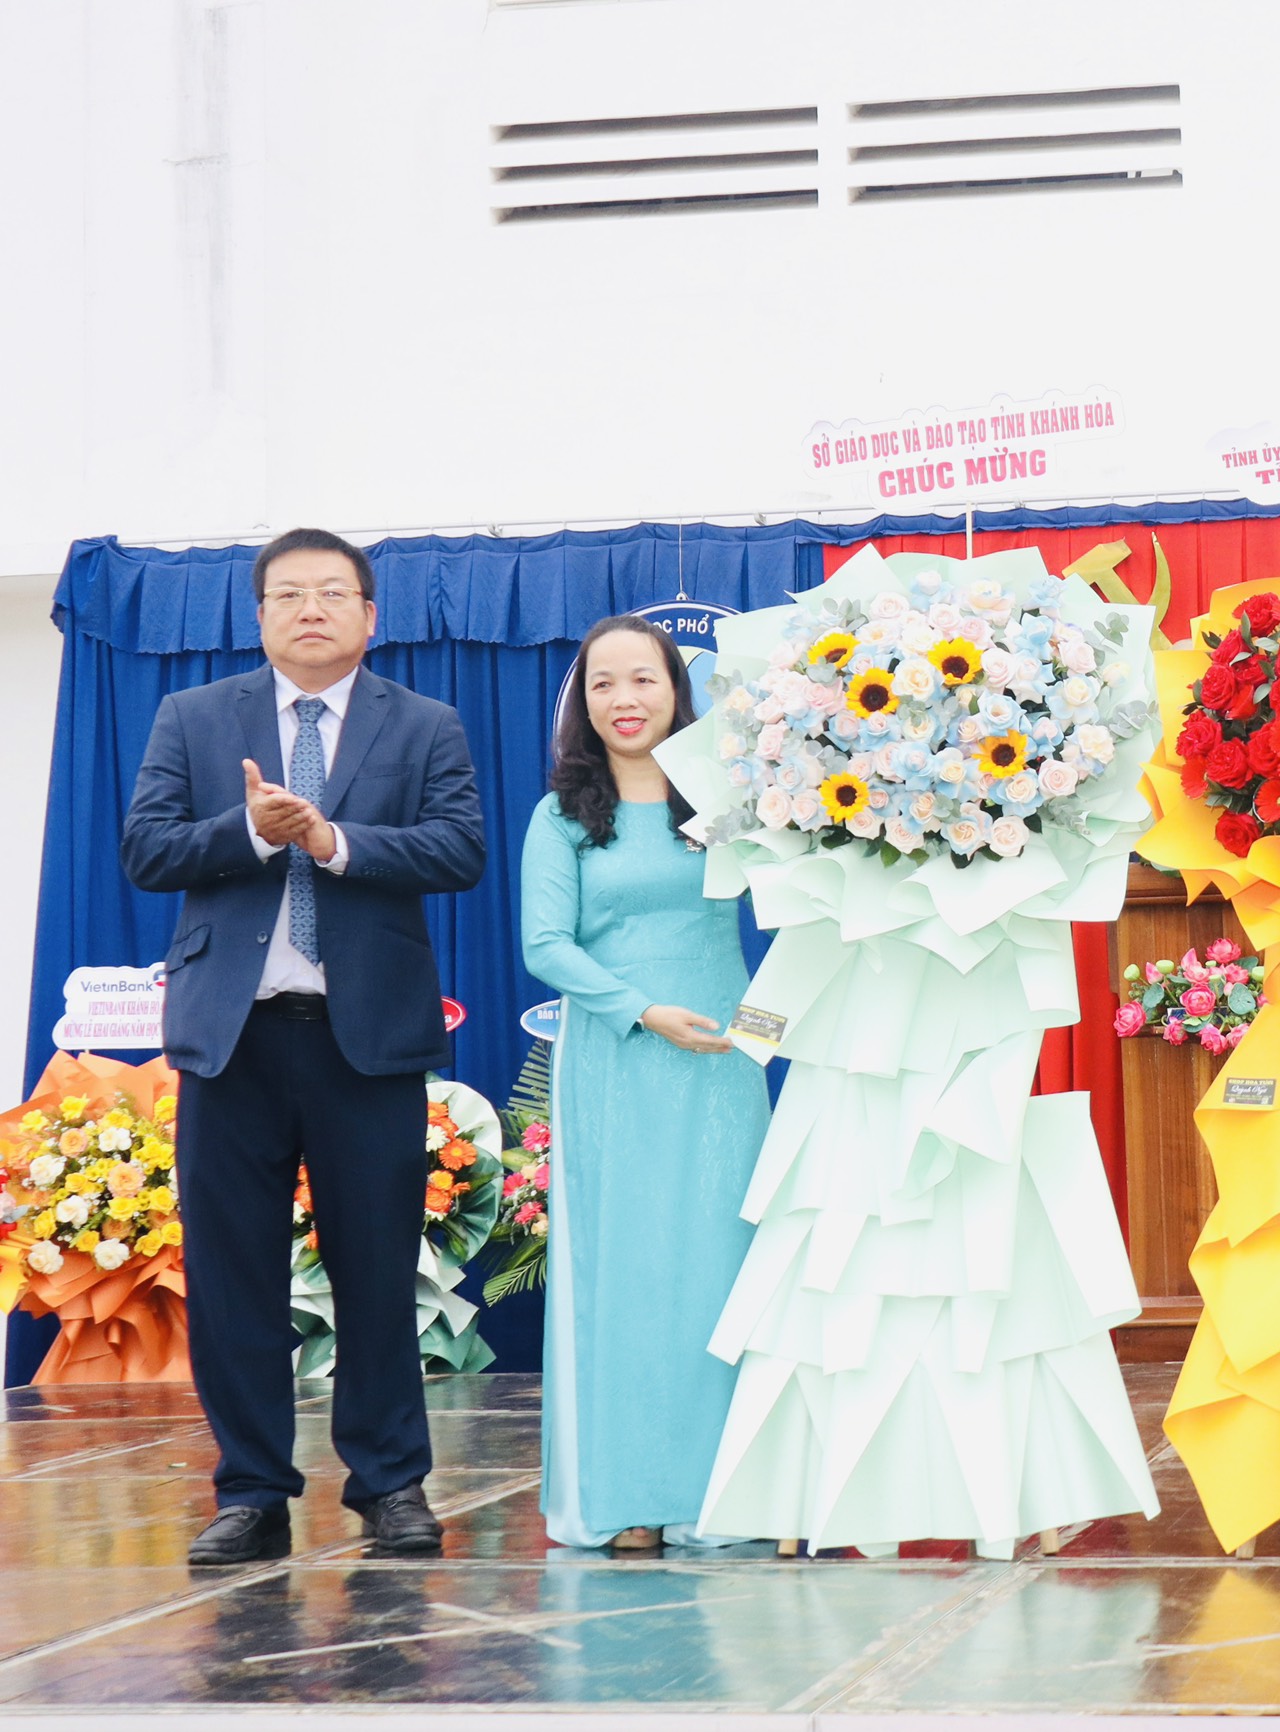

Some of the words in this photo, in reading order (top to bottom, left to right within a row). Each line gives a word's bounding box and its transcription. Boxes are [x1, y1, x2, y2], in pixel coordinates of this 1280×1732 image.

[812, 433, 830, 468] SỞ
[835, 430, 867, 464] GIÁO
[871, 431, 899, 463] DỤC
[902, 420, 921, 453] VÀ
[925, 417, 953, 450] ĐÀO
[957, 418, 987, 450] TẠO
[991, 405, 1026, 440] TỈNH
[1030, 401, 1080, 436] KHÁNH
[1084, 395, 1115, 429] HÒA
[1222, 447, 1258, 468] TỈNH
[1262, 443, 1280, 463] ỦY
[878, 457, 955, 497] CHÚC
[964, 447, 1046, 486] MỪNG
[677, 613, 710, 635] PHỔ
[81, 981, 153, 992] VietinBank
